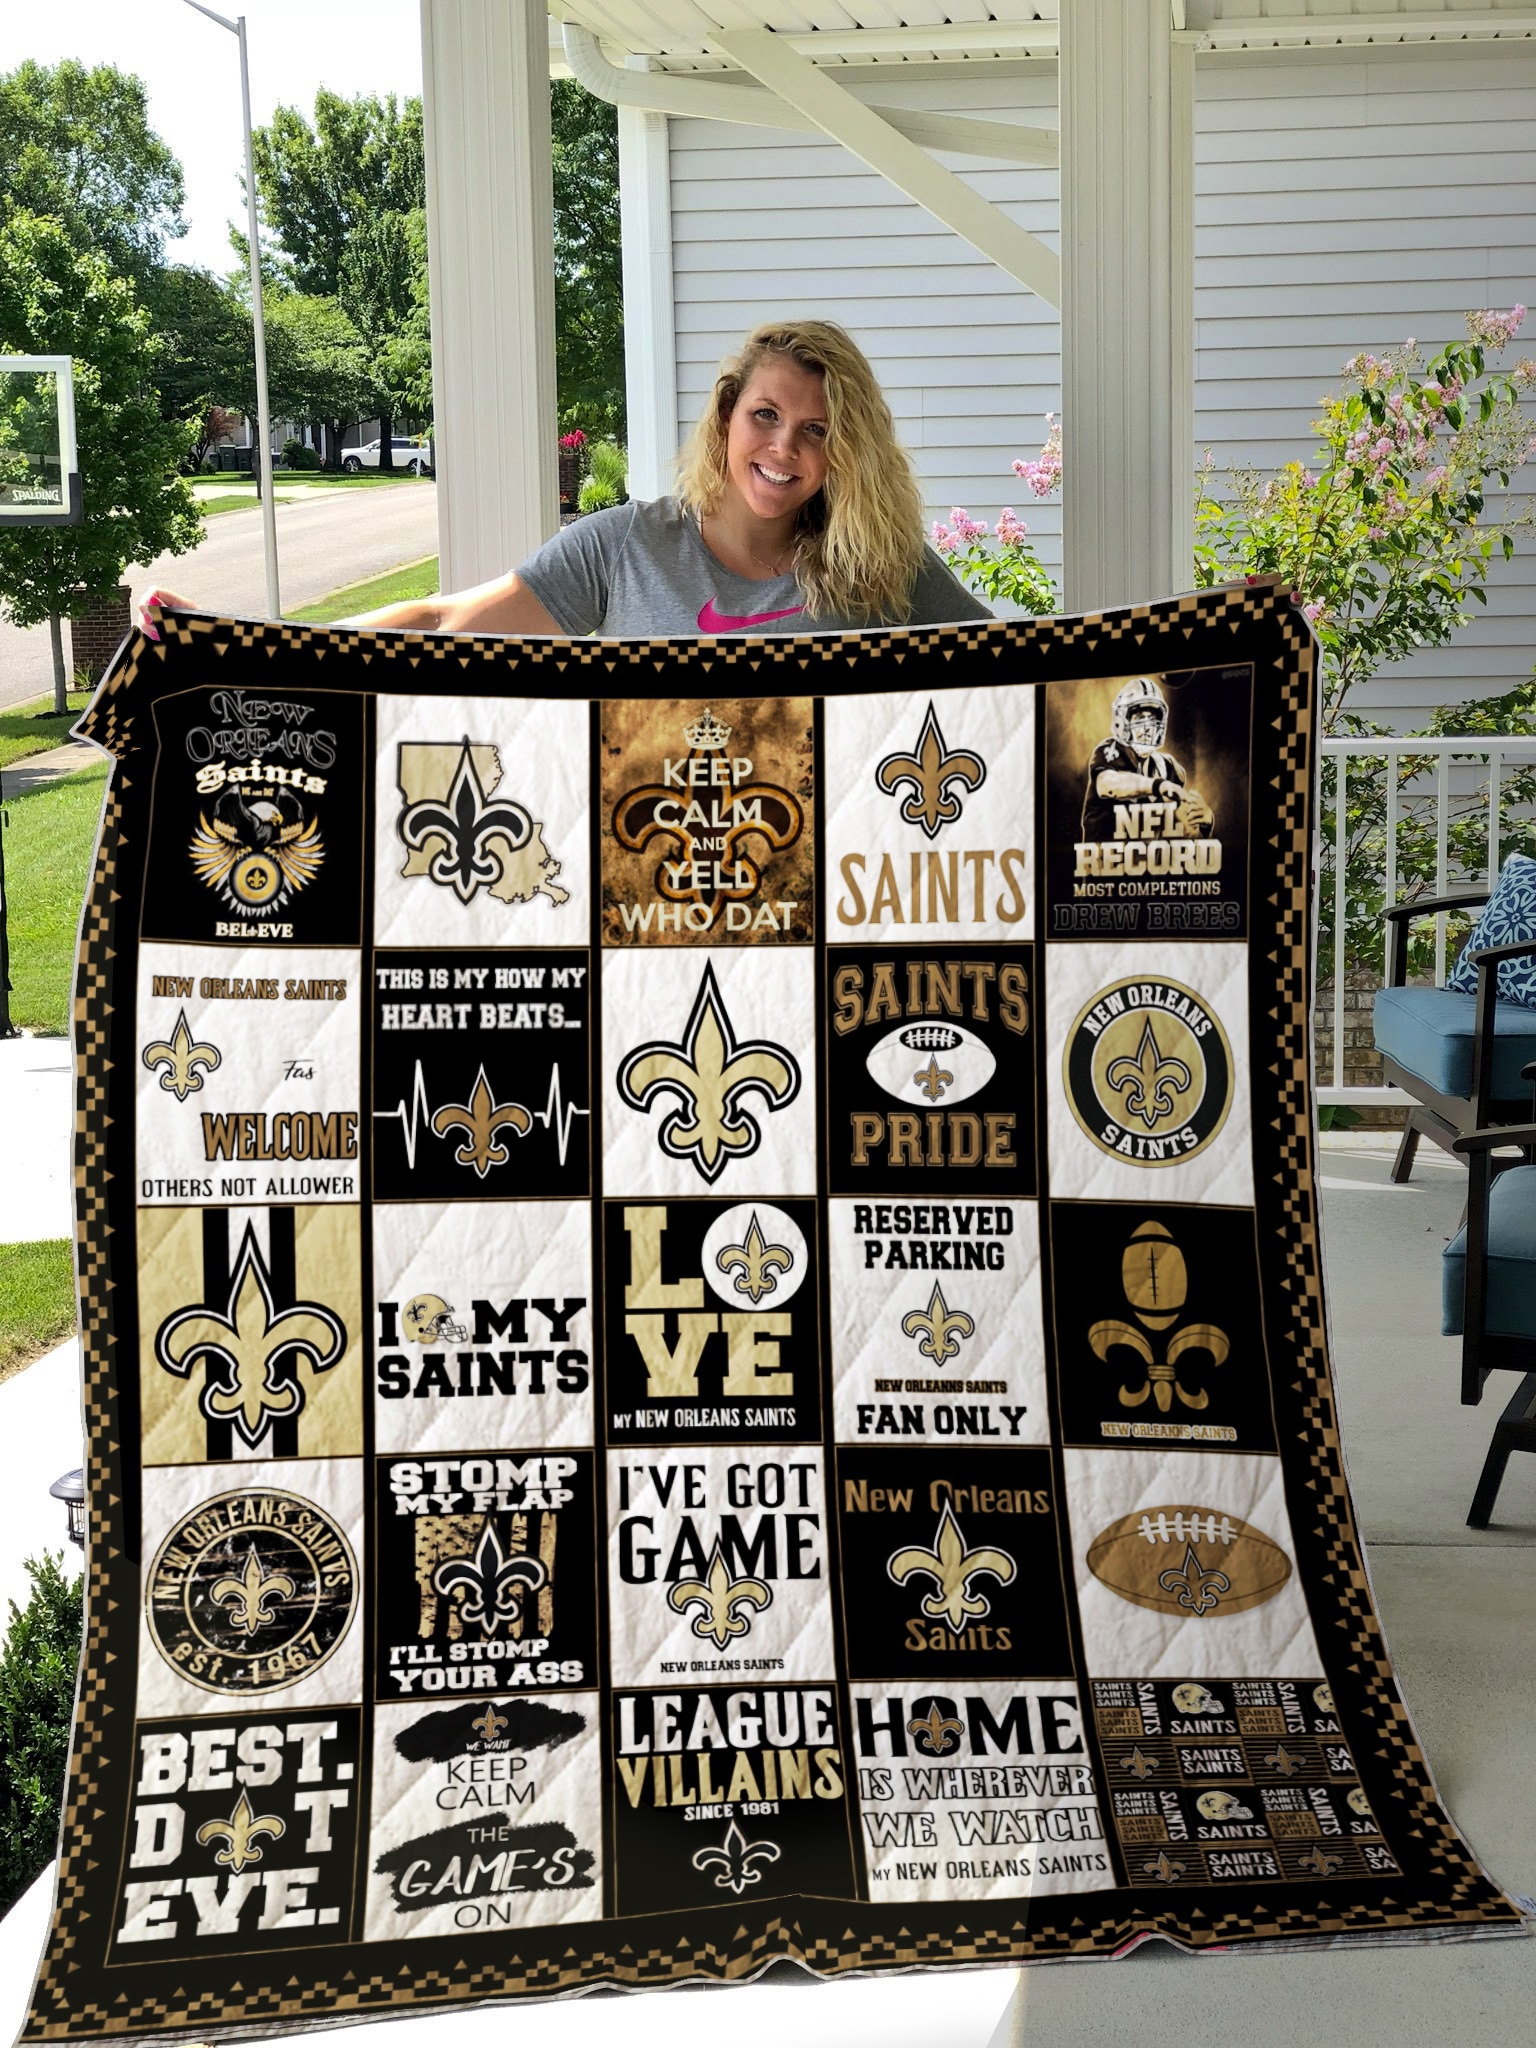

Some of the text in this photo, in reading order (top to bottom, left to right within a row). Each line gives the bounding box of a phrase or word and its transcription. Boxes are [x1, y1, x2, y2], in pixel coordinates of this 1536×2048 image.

[12, 490, 60, 501] SPALDING
[196, 758, 328, 794] Saints
[663, 757, 754, 788] KEEP
[653, 799, 762, 829] CALM
[1113, 801, 1185, 839] NFL
[689, 836, 728, 851] AND
[1073, 838, 1222, 877] RECORD
[663, 860, 755, 889] YELL
[836, 848, 1026, 926] SAINTS
[1073, 881, 1221, 897] MOST COMPLETIONS
[619, 901, 798, 932] WHO DAT
[1054, 901, 1240, 930] DREW BREES
[152, 975, 347, 1000] NEW ORLEANS SAINTS
[376, 967, 586, 989] THIS IS MY HOW MY
[833, 961, 1029, 1036] SAINTS
[1082, 985, 1213, 1037] NEW ORLEANS
[381, 1003, 472, 1030] HEART
[200, 1111, 358, 1161] WELCOME
[851, 1112, 1017, 1167] PRIDE
[1101, 1124, 1199, 1159] SAINTS
[142, 1177, 354, 1198] OTHERS NOT ALLOWER
[854, 1205, 1014, 1235] RESERVED
[864, 1240, 1005, 1270] PARKING
[378, 1298, 587, 1347] I MY
[378, 1349, 589, 1399] SAINTS
[874, 1378, 904, 1392] NEW
[966, 1381, 1008, 1394] SAINTS
[613, 1408, 796, 1429] MY NEW ORLEANS SAINTS
[856, 1404, 1027, 1436] FAN ONLY
[1100, 1422, 1132, 1438] NEW
[1192, 1424, 1237, 1441] SAINTS
[389, 1457, 578, 1495] STOMP
[619, 1463, 817, 1511] I'VE GOT
[395, 1489, 574, 1516] MY FLAP
[844, 1479, 1051, 1514] New Orleans
[154, 1499, 350, 1600] NEW ORLEANS SAINTS
[619, 1513, 821, 1584] GAME
[248, 1631, 322, 1685] 1967
[389, 1638, 549, 1665] I'LL STOMP
[660, 1659, 785, 1673] NEW ORLEANS SAINTS
[389, 1660, 584, 1693] YOUR ASS
[1094, 1682, 1132, 1690] SAINTS
[1232, 1682, 1274, 1690] SAINTS
[1096, 1690, 1134, 1698] SAINTS
[1096, 1698, 1136, 1706] SAINTS
[1136, 1682, 1162, 1735] SAINTS
[1234, 1690, 1276, 1698] SAINTS
[1236, 1698, 1278, 1706] SAINTS
[1276, 1682, 1306, 1734] SAINTS
[619, 1690, 834, 1754] LEAGUE
[855, 1695, 1084, 1758] HOME
[1170, 1719, 1237, 1735] SAINTS
[137, 1721, 354, 1796] BEST.
[466, 1741, 480, 1752] WE
[1180, 1748, 1242, 1762] SAINTS
[447, 1757, 527, 1784] KEEP
[616, 1748, 844, 1808] VILLAINS
[1183, 1761, 1246, 1774] SAINTS
[436, 1781, 535, 1810] CALM
[859, 1765, 1096, 1800] IS WHEREVER
[1114, 1792, 1155, 1800] SAINTS
[1260, 1788, 1304, 1796] SAINTS
[684, 1801, 780, 1821] SINCE 1981
[1115, 1800, 1156, 1808] SAINTS
[1116, 1808, 1158, 1816] SAINTS
[1262, 1796, 1306, 1804] SAINTS
[1308, 1788, 1342, 1836] SAINTS
[863, 1807, 1105, 1848] WE WATCH
[1160, 1791, 1189, 1840] SAINTS
[467, 1826, 509, 1844] THE
[1197, 1824, 1268, 1838] SAINTS
[399, 1847, 576, 1898] GAME'S
[872, 1854, 1107, 1881] MY NEW ORLEANS SAINTS
[1208, 1852, 1274, 1865] SAINTS
[1212, 1864, 1278, 1878] SAINTS
[116, 1866, 340, 1943] EVE.
[454, 1902, 512, 1928] ON
